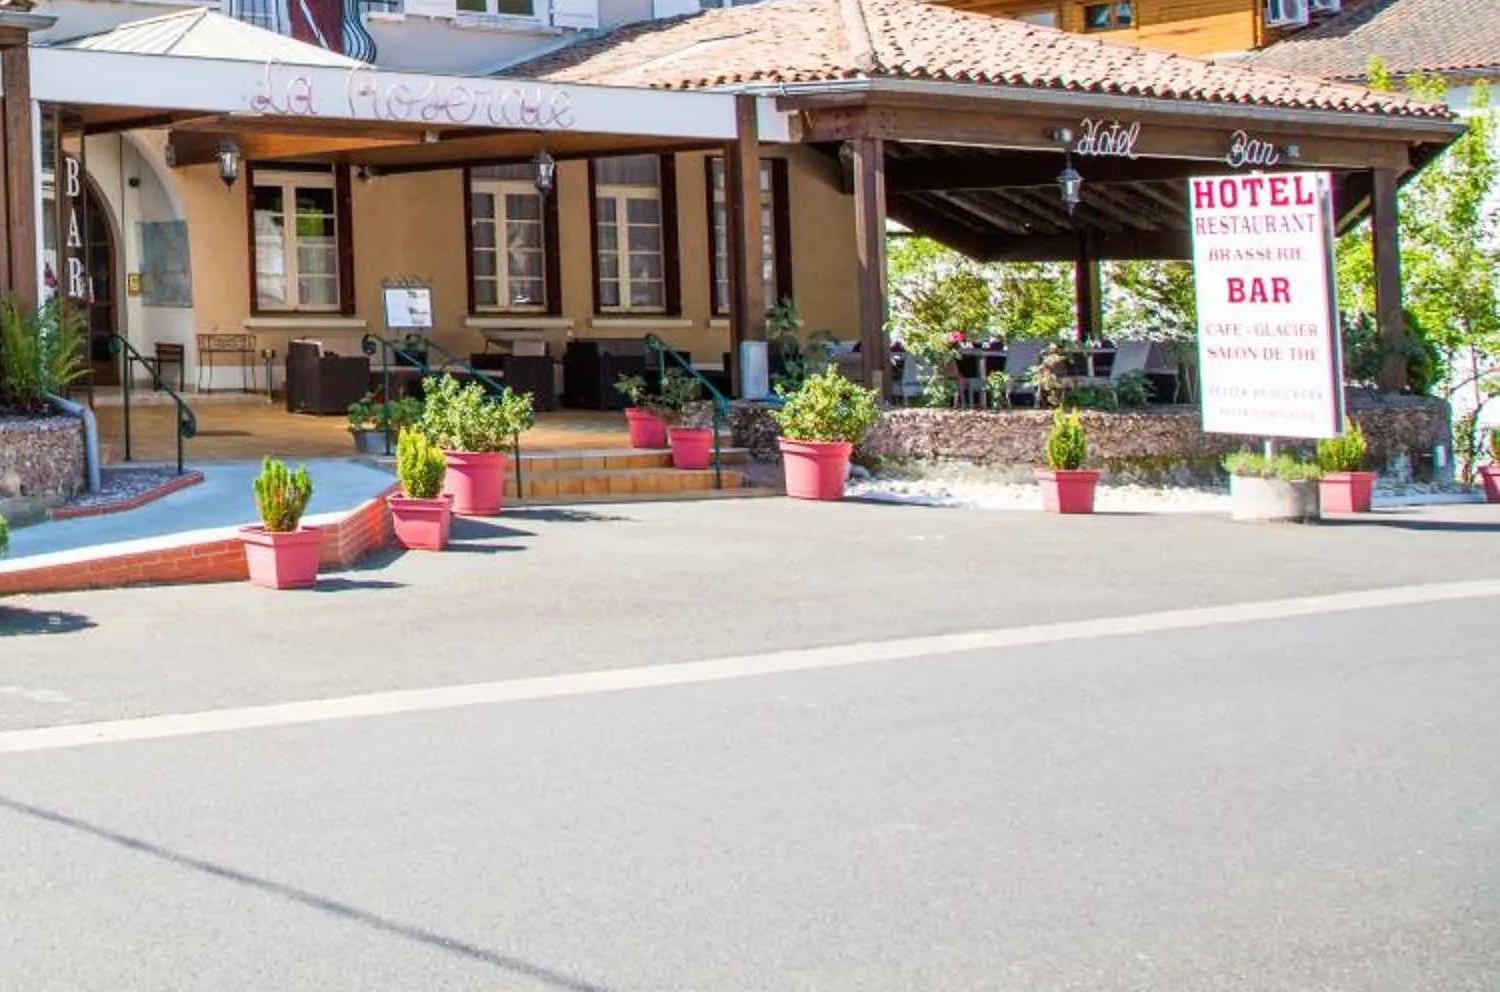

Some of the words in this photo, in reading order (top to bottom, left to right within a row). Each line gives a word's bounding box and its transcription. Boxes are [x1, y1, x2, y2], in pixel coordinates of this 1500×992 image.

[250, 57, 318, 116] La
[1075, 117, 1140, 160] Hotel
[1226, 129, 1280, 167] Bar
[1193, 175, 1315, 209] HOTEL
[66, 157, 84, 298] BAR
[1195, 213, 1317, 236] RESTAURANT
[1208, 246, 1307, 262] BRASSERIE
[1226, 276, 1292, 304] BAR
[1253, 323, 1319, 338] GLACIER
[1206, 346, 1258, 360] SALON
[1263, 347, 1284, 361] DE
